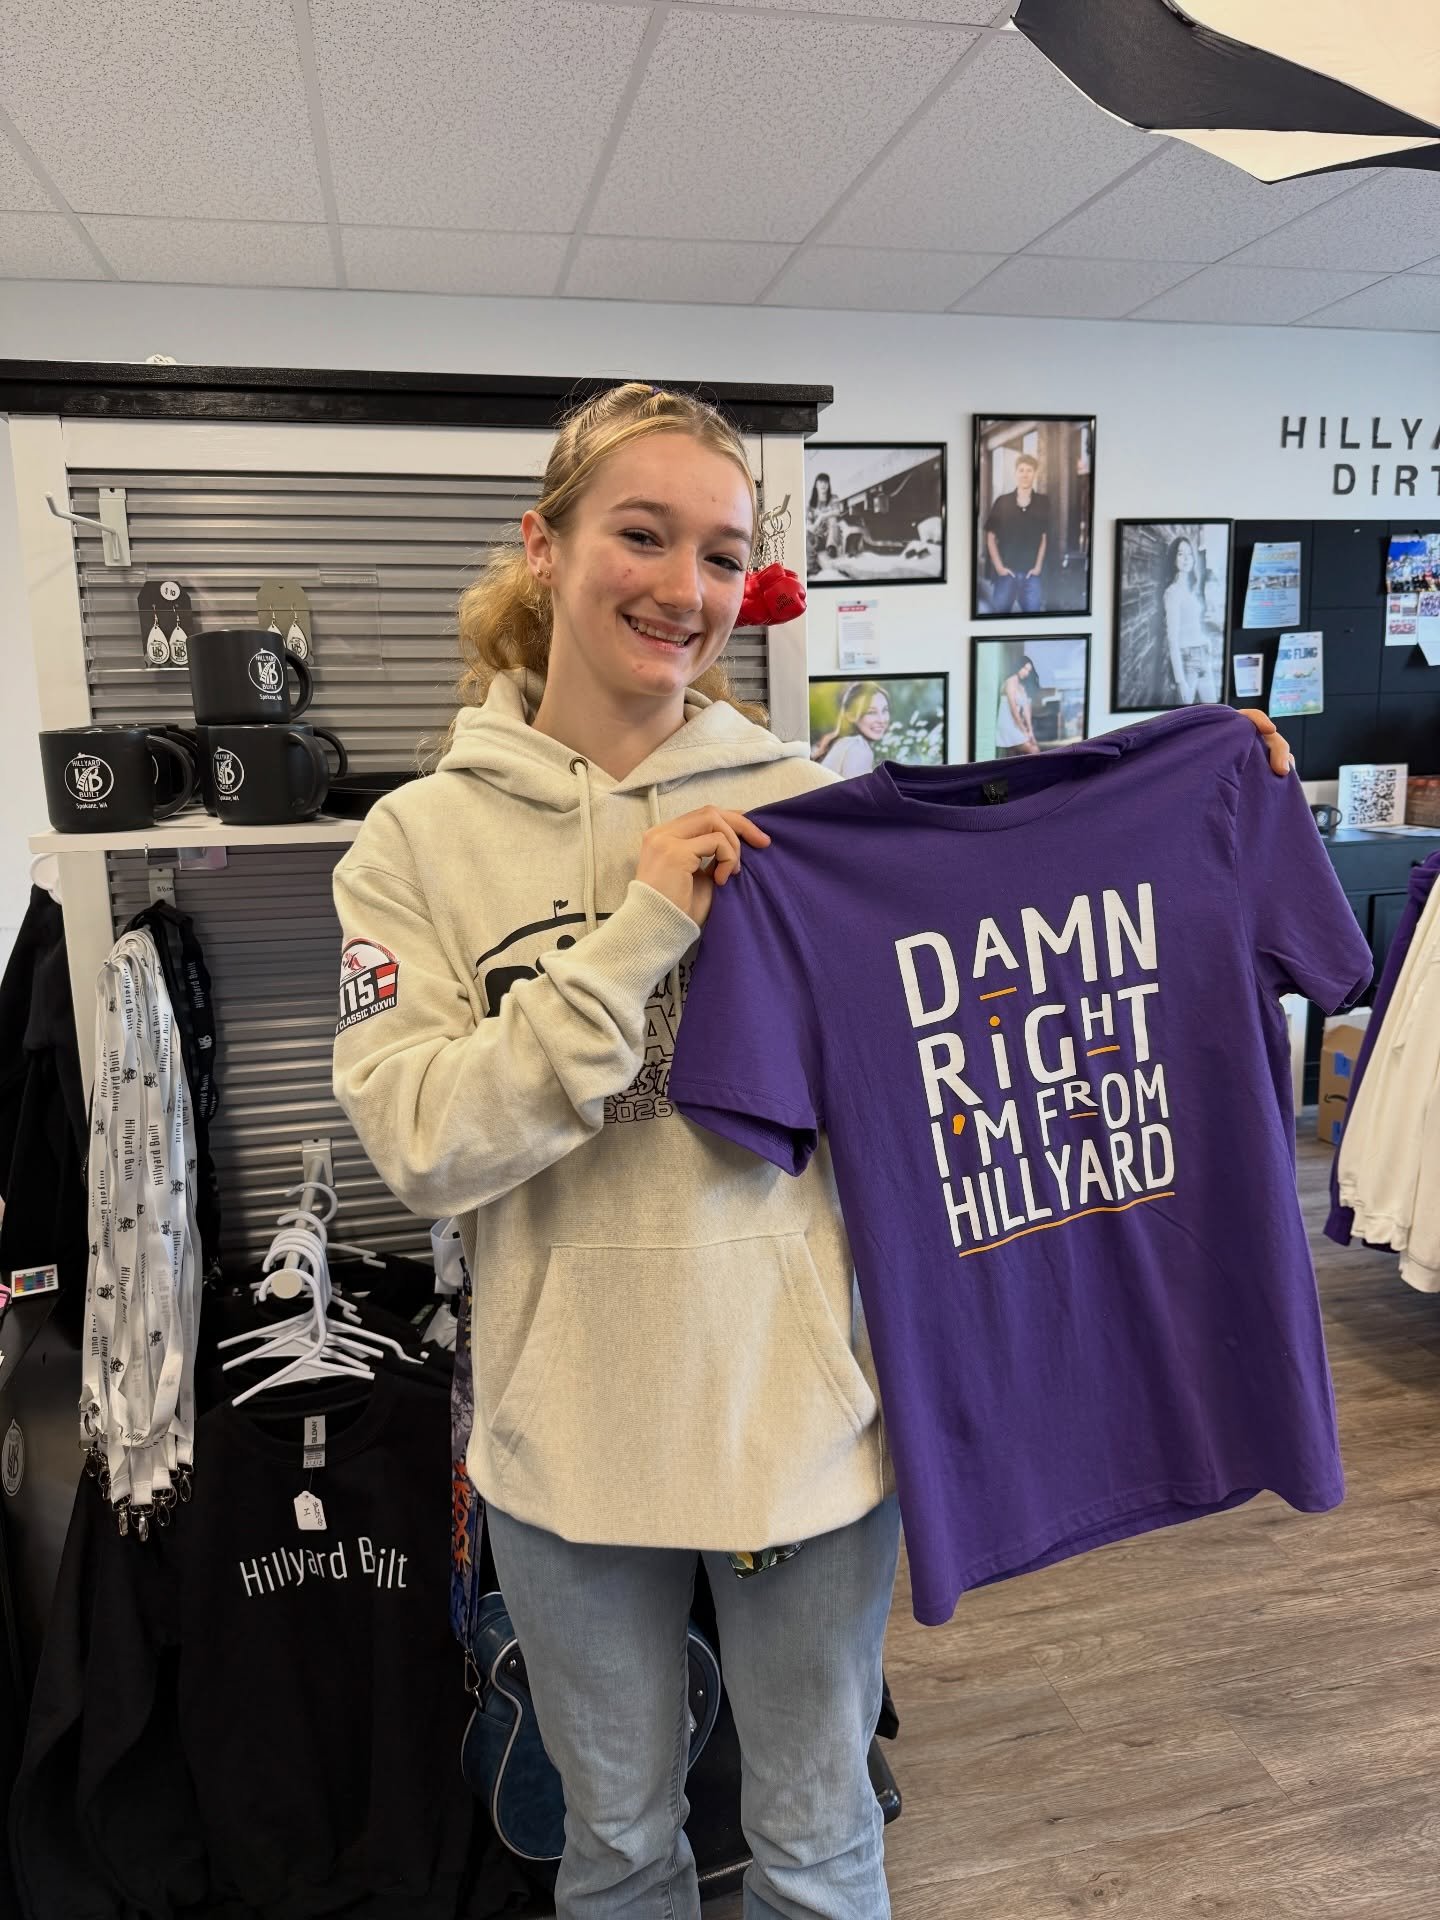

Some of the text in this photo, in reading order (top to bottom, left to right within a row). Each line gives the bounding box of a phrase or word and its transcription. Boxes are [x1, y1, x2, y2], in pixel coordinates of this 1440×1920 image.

[894, 883, 1158, 1028] DAMN
[339, 1008, 370, 1030] CLASSIC
[370, 996, 396, 1015] XXXVII
[109, 1049, 120, 1073] Built
[159, 1037, 170, 1073] Hillyard
[122, 1119, 136, 1181] Hillyard Built
[930, 1063, 1170, 1178] I'M FROM
[147, 1123, 165, 1186] Hillyard Built
[942, 1123, 1175, 1248] HILLYARD
[119, 1266, 131, 1300] Hillyard
[239, 1536, 408, 1597] Hillyard Bilt
